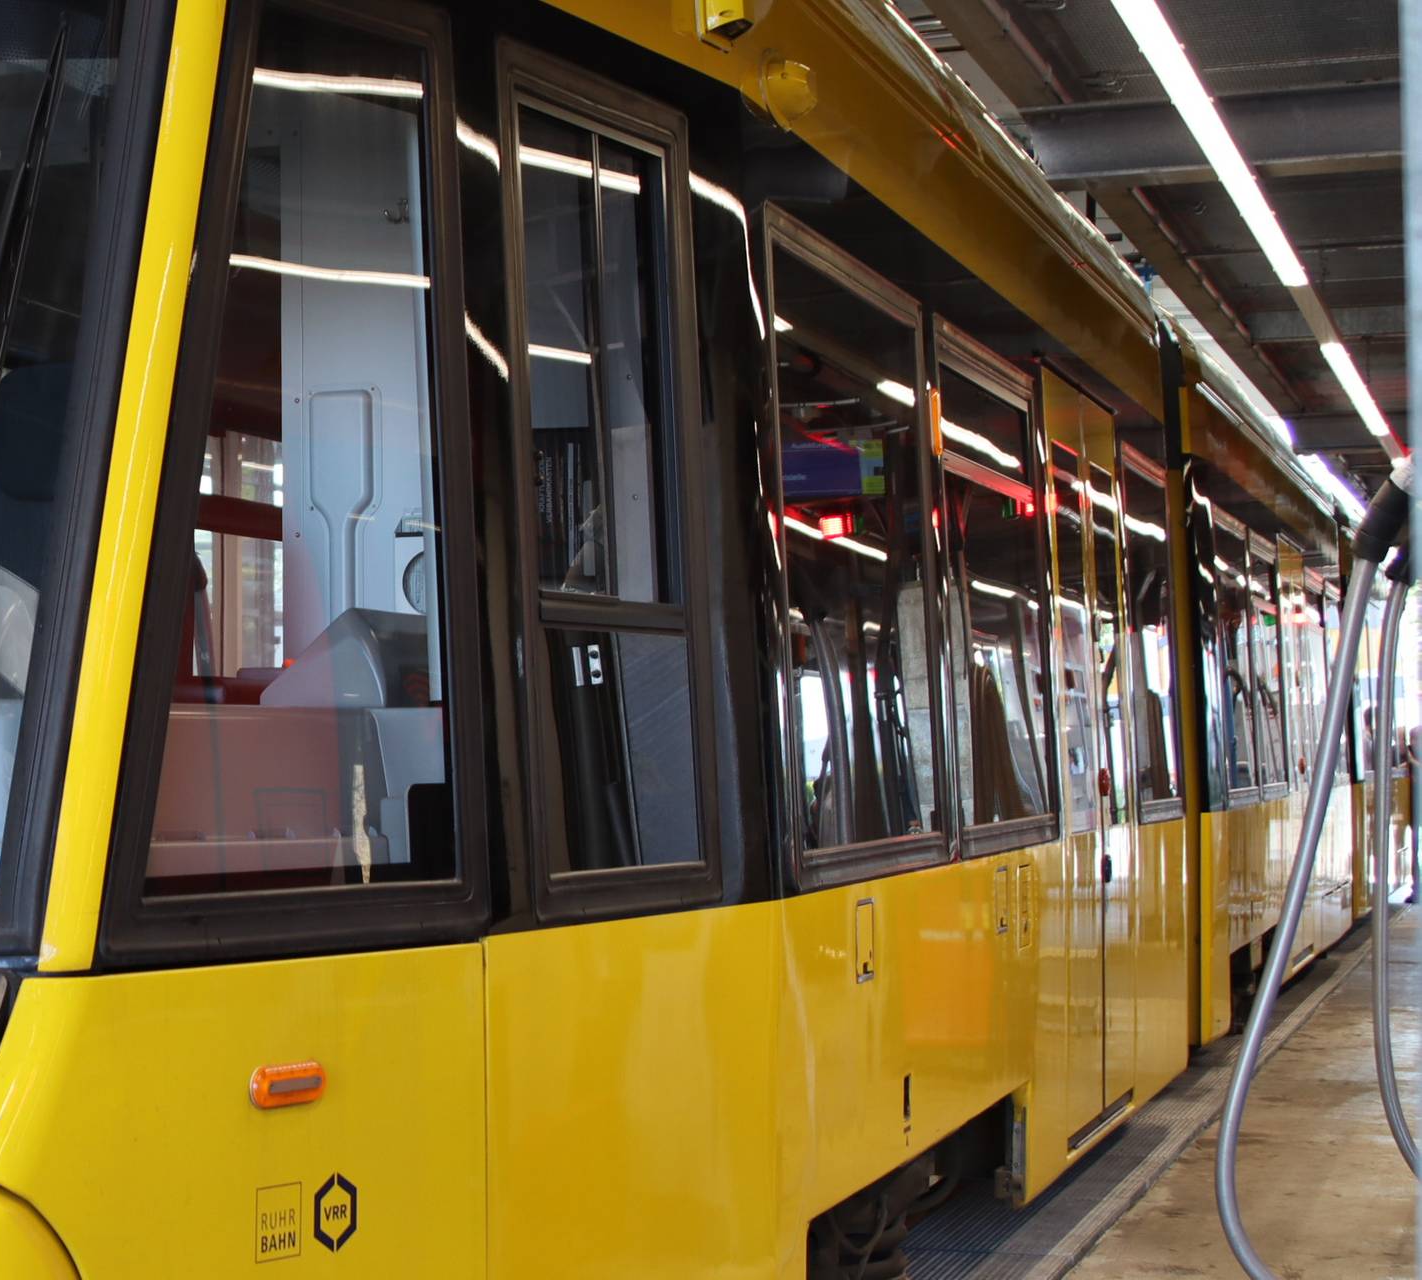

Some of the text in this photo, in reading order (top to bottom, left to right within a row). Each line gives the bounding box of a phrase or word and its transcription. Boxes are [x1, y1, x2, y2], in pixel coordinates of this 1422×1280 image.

[261, 1208, 296, 1231] RUHR
[324, 1204, 348, 1222] VRR
[261, 1231, 296, 1254] BAHN
